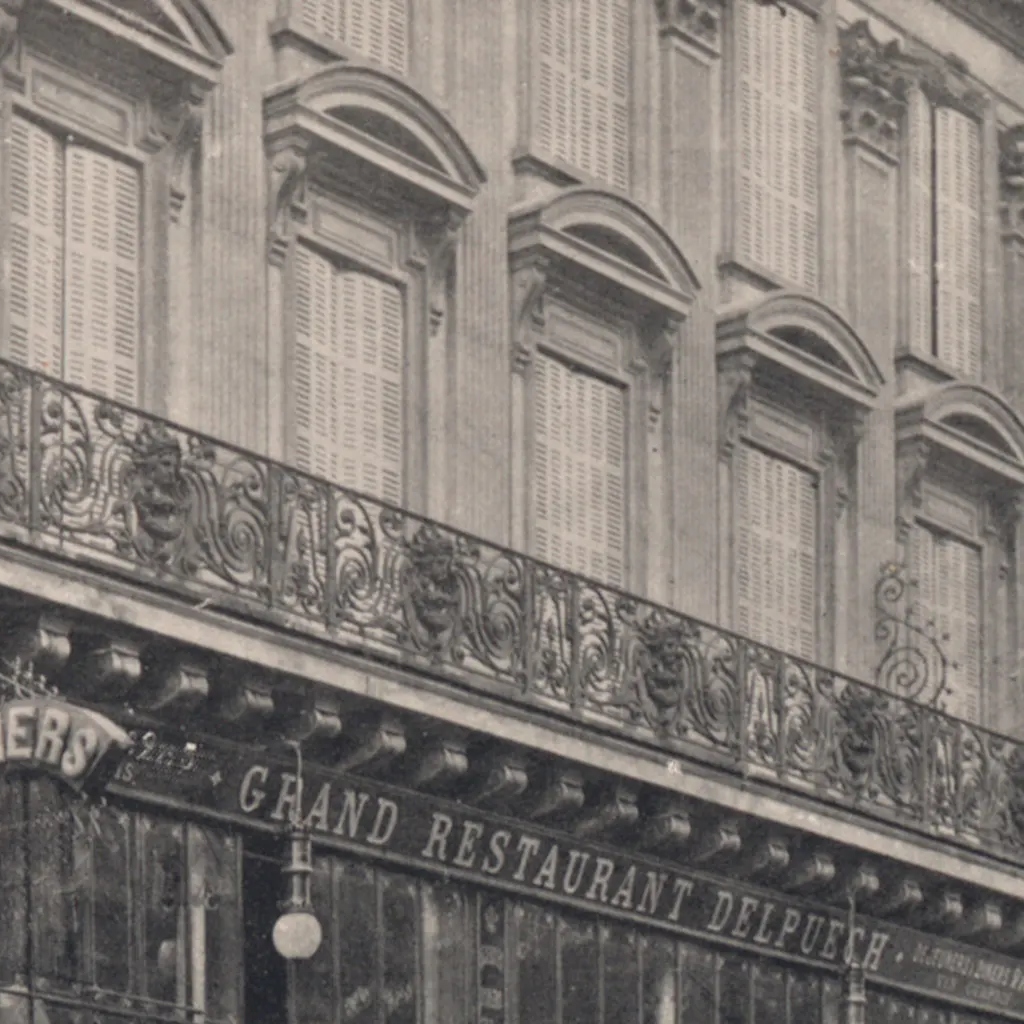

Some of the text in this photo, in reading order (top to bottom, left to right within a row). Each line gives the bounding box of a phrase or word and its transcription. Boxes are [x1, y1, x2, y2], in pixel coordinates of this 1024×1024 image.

[239, 766, 398, 846] GRAND
[422, 812, 693, 921] RESTAURANT
[708, 890, 889, 972] DELPUECH
